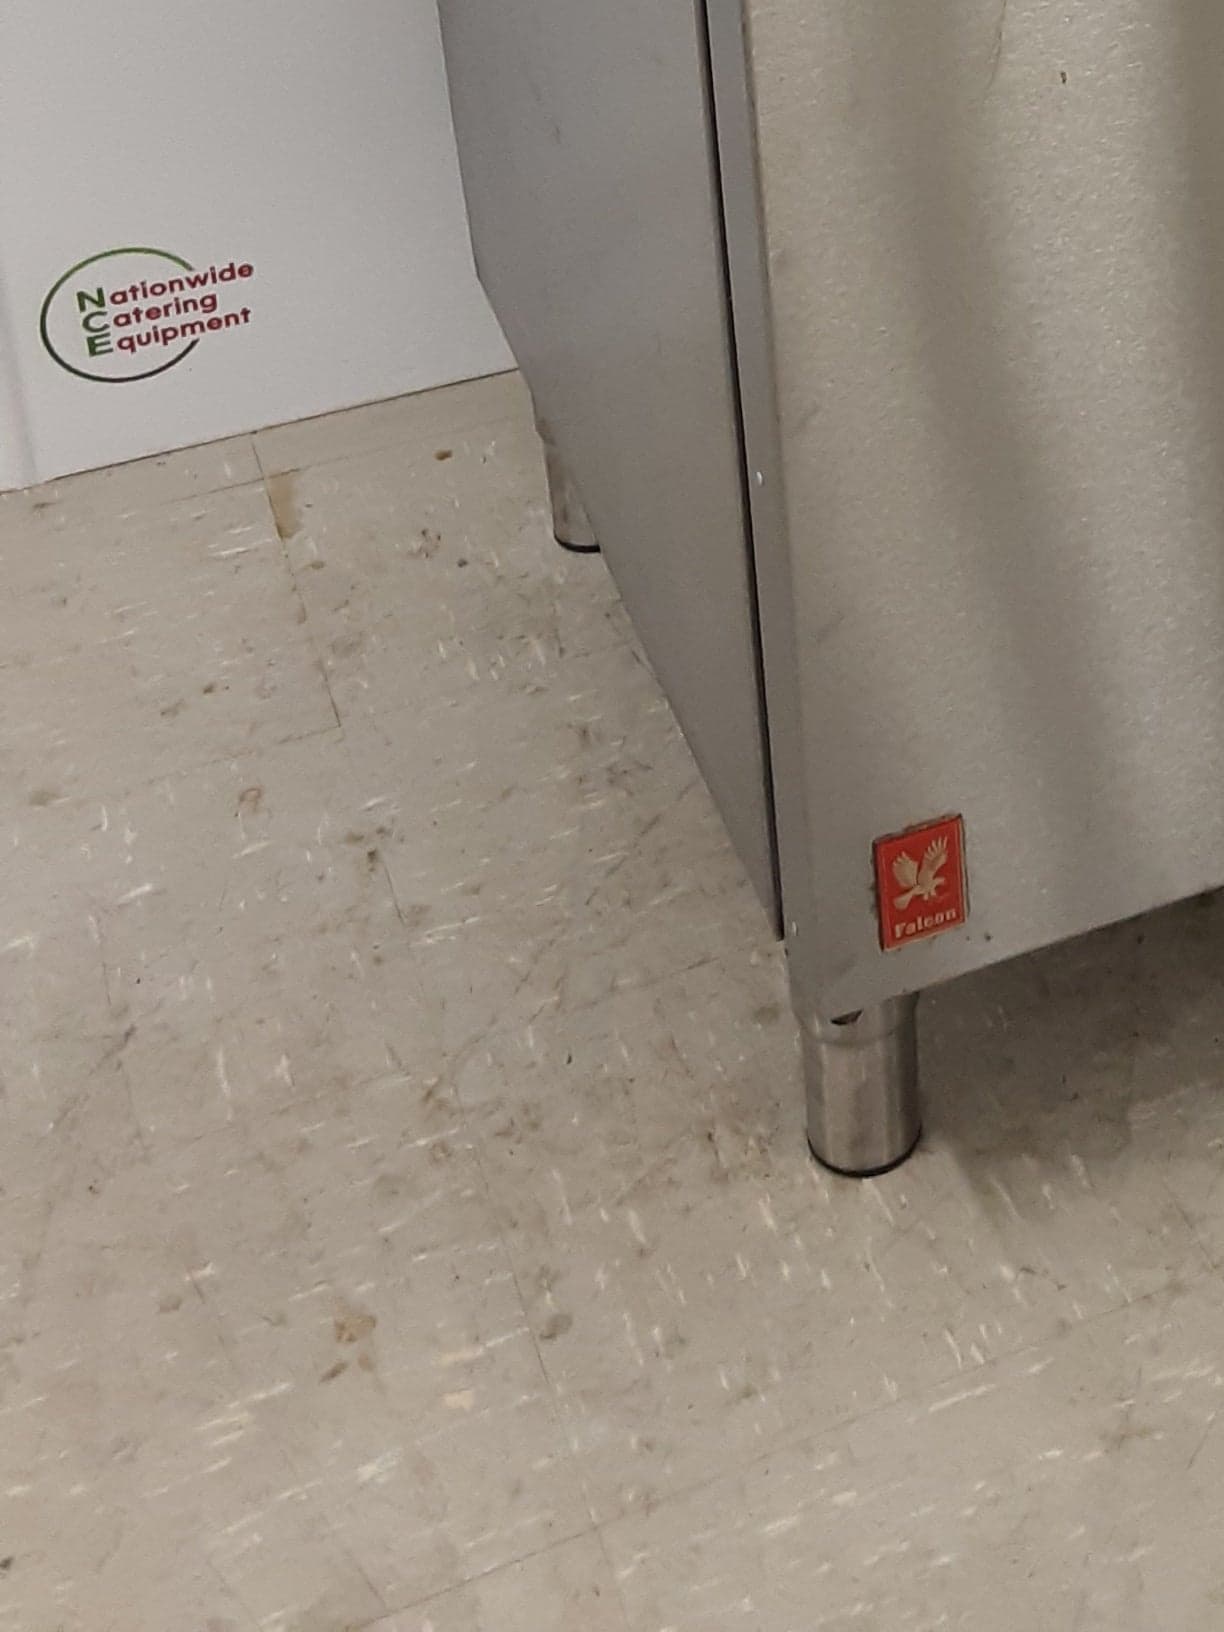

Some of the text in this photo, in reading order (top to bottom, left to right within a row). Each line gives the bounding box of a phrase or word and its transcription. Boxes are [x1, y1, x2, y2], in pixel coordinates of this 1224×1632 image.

[76, 262, 255, 313] Nationwide
[81, 293, 218, 333] Catering
[86, 307, 252, 358] Equipment
